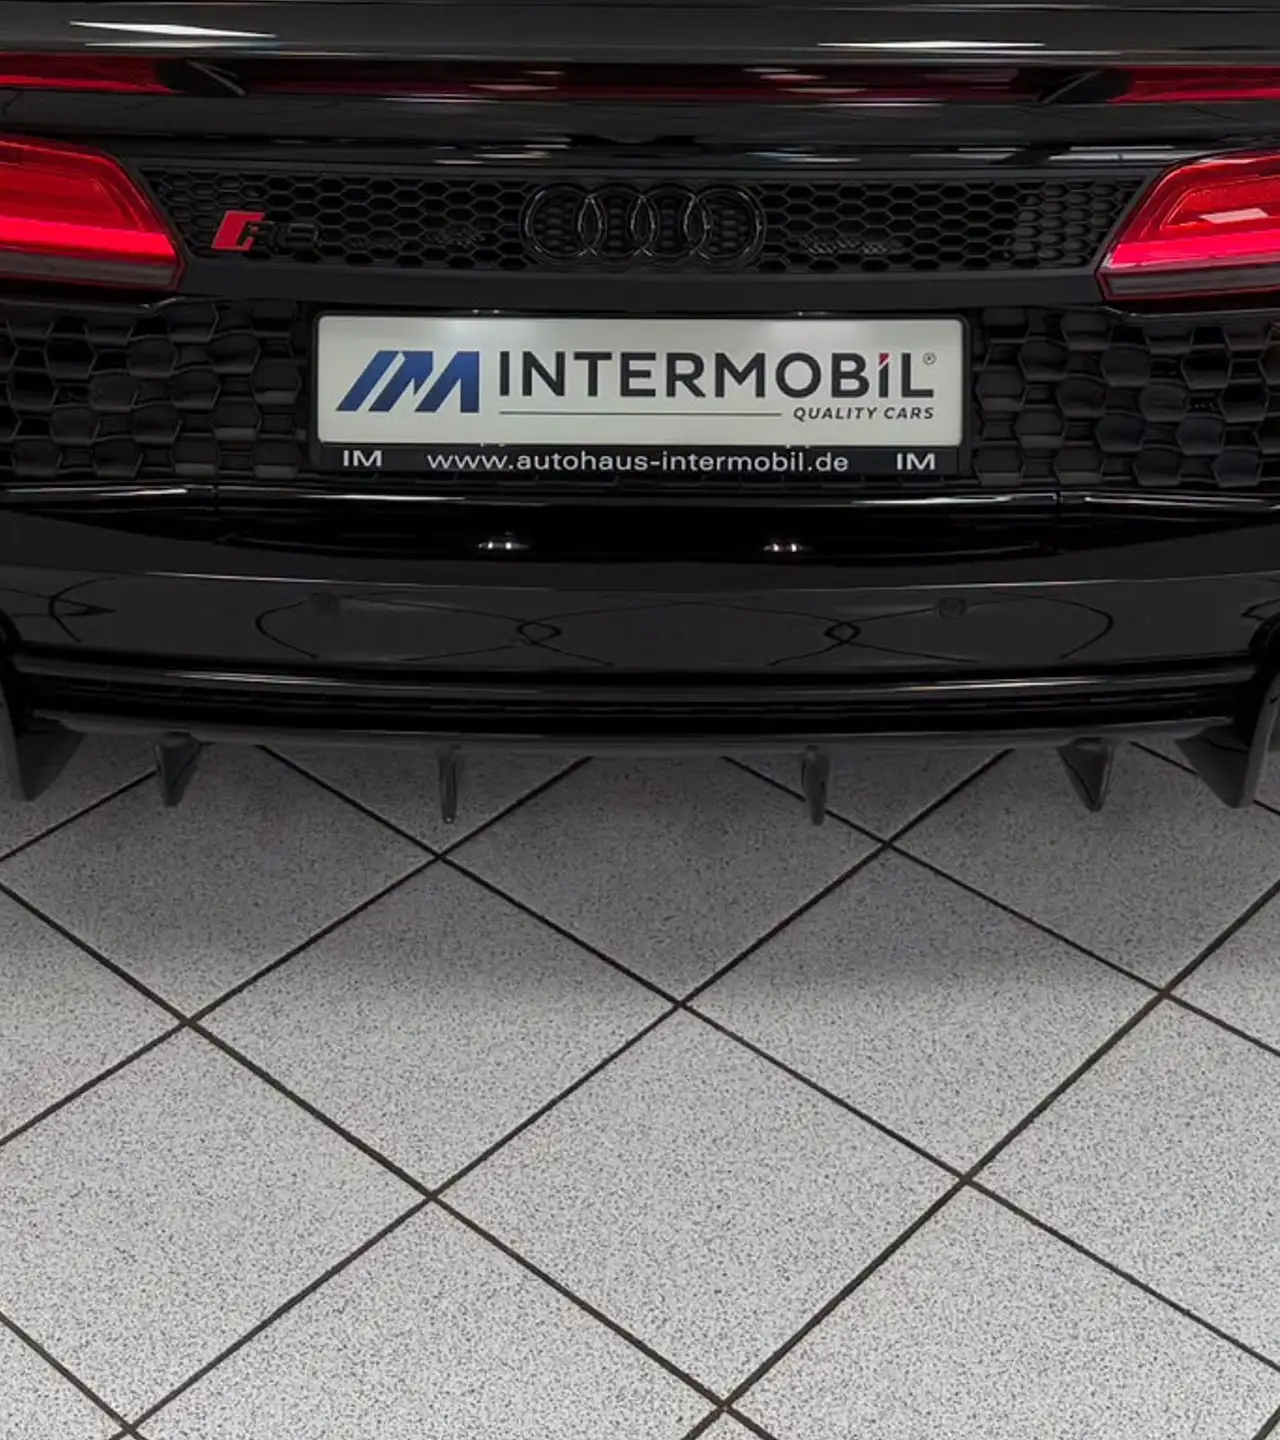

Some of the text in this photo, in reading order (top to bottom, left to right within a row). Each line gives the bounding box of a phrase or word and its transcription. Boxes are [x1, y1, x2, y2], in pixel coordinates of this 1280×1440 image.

[793, 407, 934, 422] QUALITY CARS
[343, 450, 936, 472] IM www.autohaus-intermobil.de IM
